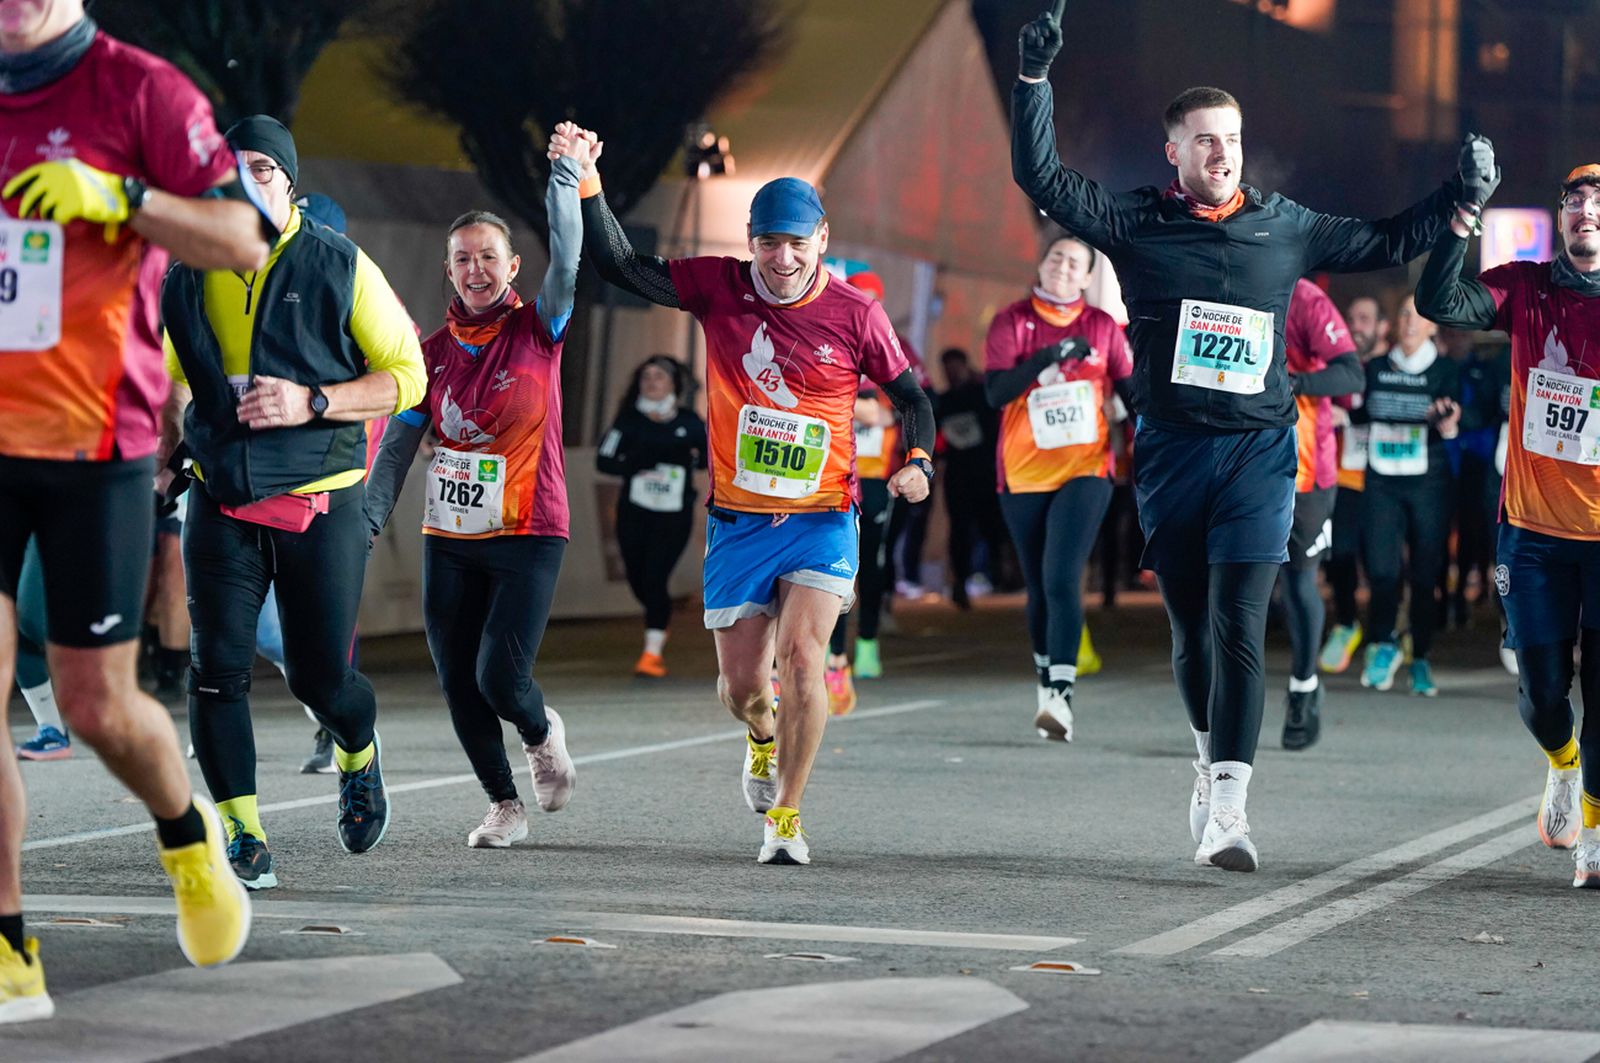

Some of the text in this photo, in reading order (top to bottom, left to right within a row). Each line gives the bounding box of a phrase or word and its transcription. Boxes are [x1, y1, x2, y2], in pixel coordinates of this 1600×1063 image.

[1190, 320, 1210, 331] SAN
[1202, 312, 1231, 323] NOCHE
[1231, 316, 1243, 325] DE
[756, 368, 781, 393] 43
[1545, 380, 1572, 393] NOCHE
[1572, 385, 1584, 395] DE
[1536, 388, 1551, 400] SAN
[1552, 391, 1583, 406] ANTÓN
[1045, 405, 1084, 426] 6521
[1546, 403, 1589, 434] 597
[746, 425, 765, 437] SAN
[757, 417, 786, 429] NOCHE
[787, 422, 799, 432] DE
[754, 438, 807, 471] 1510
[460, 460, 471, 470] DE
[447, 469, 471, 481] TÓN
[438, 477, 485, 508] 7262
